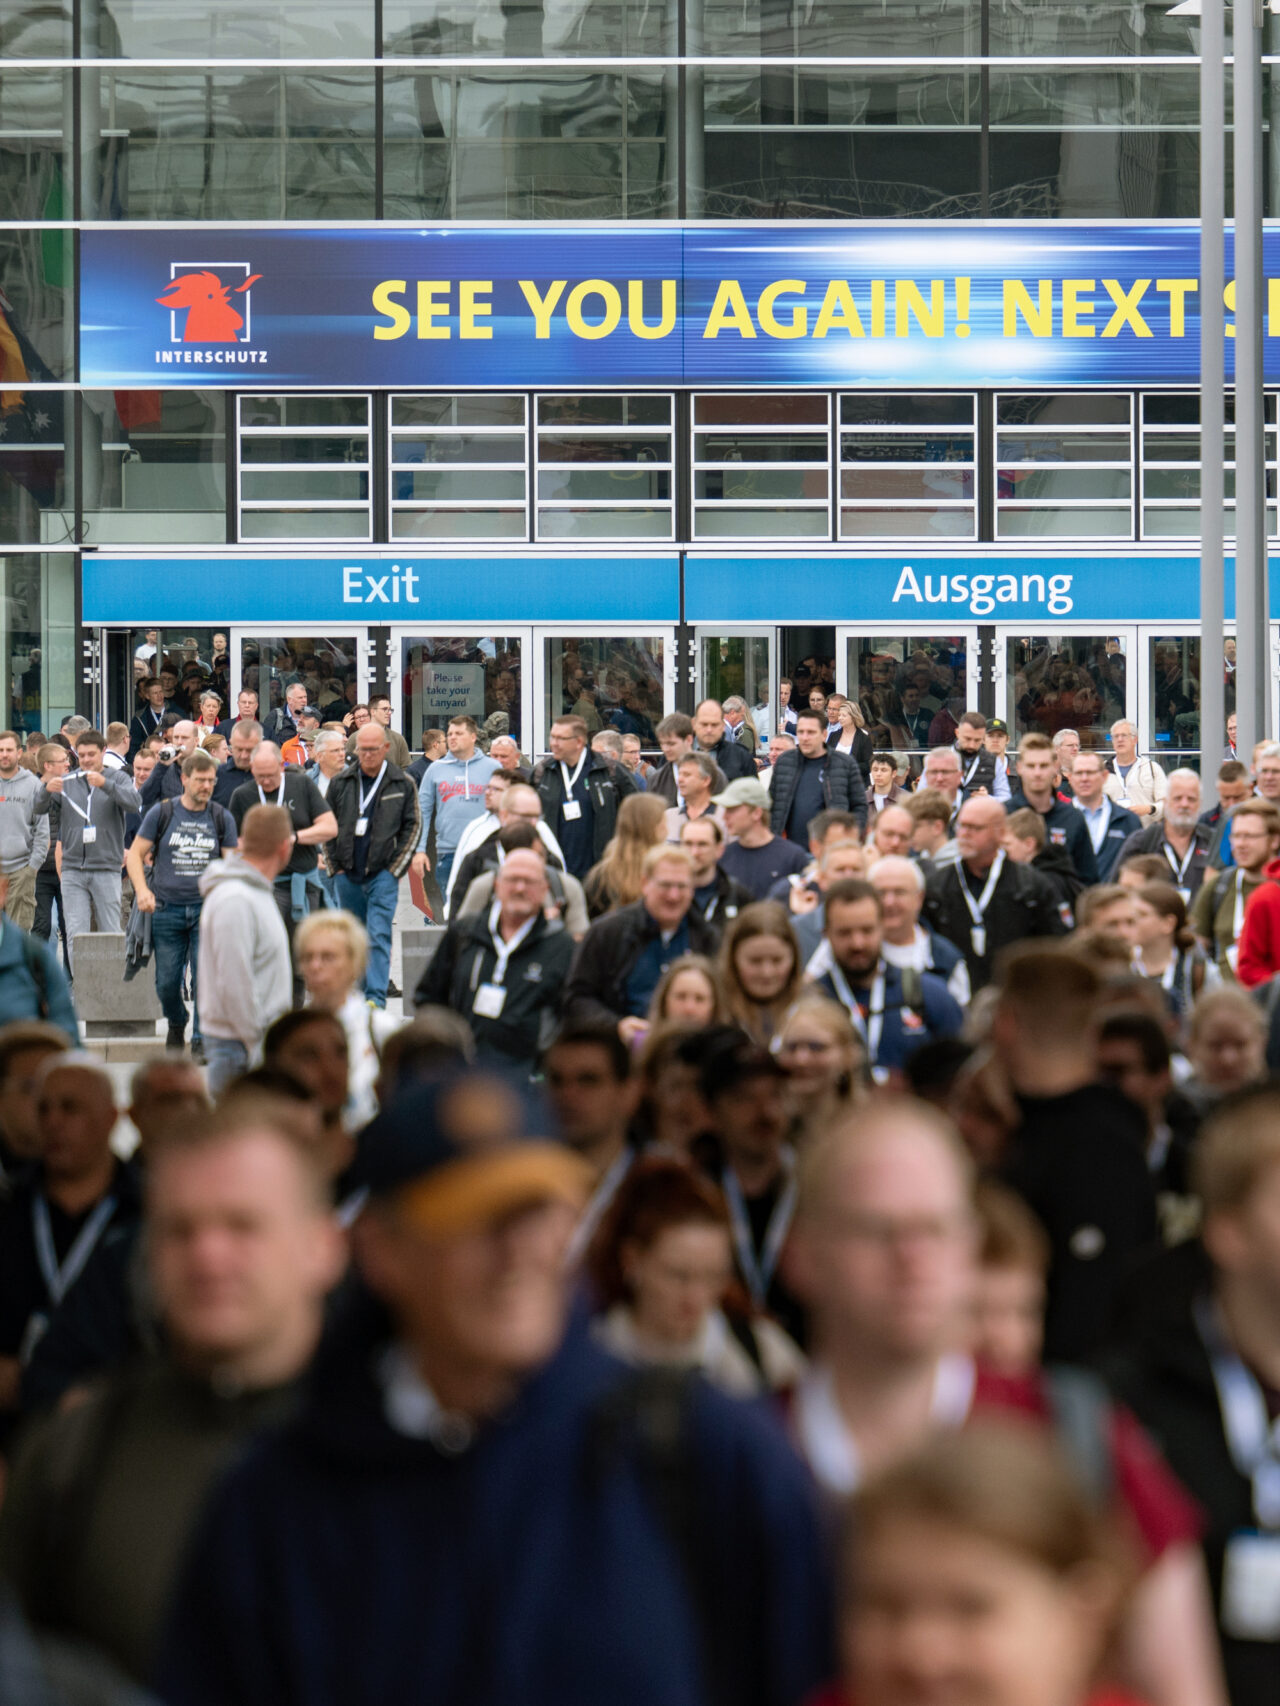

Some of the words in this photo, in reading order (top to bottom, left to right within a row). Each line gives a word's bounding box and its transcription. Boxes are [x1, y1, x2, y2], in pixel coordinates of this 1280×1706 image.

[372, 279, 493, 340] SEE
[518, 279, 677, 340] YOU
[703, 277, 971, 339] AGAIN!
[1003, 278, 1198, 338] NEXT
[155, 350, 268, 364] INTERSCHUTZ
[342, 565, 420, 604] Exit
[891, 566, 1074, 615] Ausgang
[427, 686, 447, 695] take
[449, 687, 470, 698] your
[430, 698, 467, 709] Lanyard
